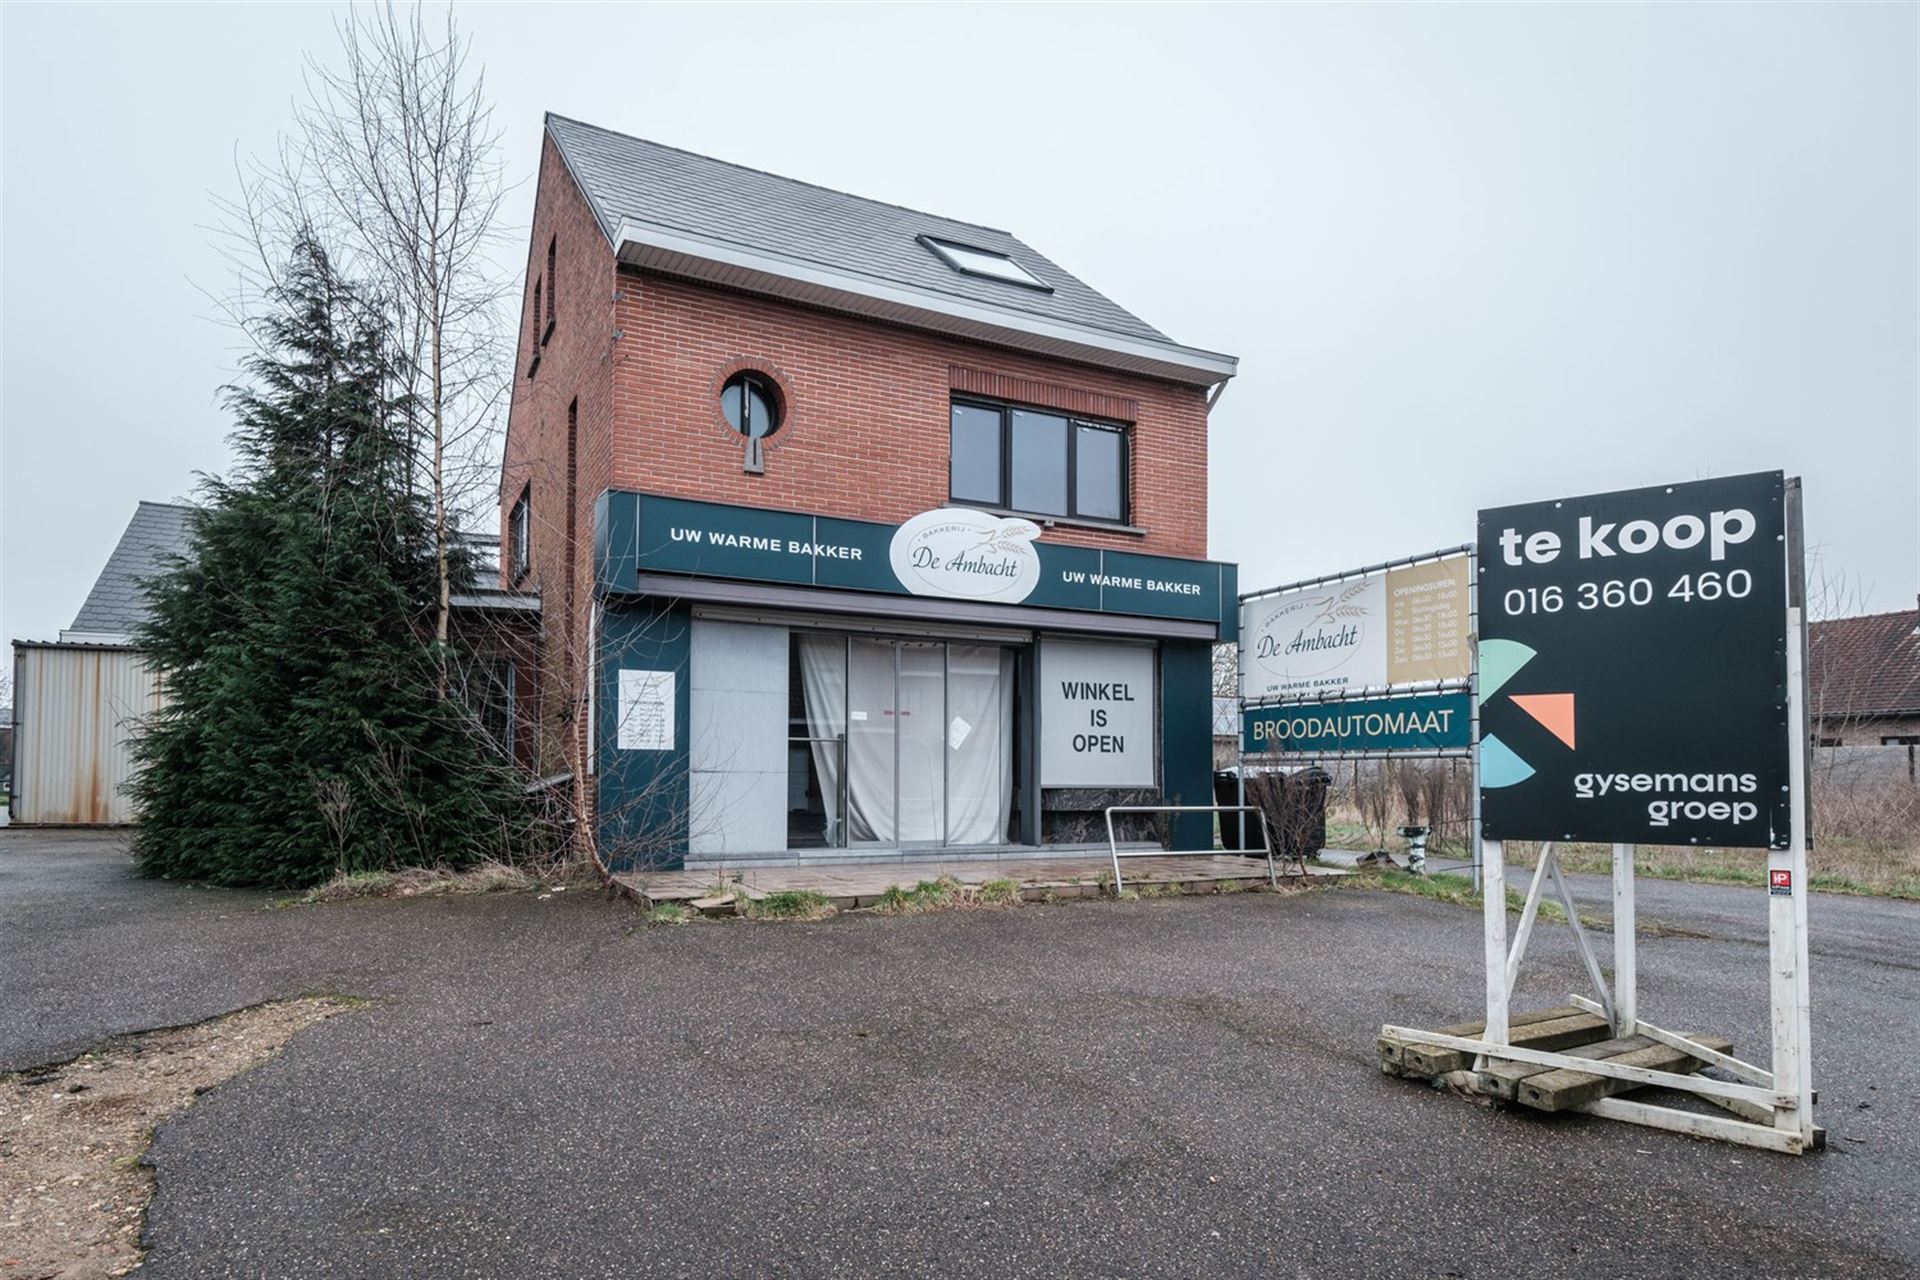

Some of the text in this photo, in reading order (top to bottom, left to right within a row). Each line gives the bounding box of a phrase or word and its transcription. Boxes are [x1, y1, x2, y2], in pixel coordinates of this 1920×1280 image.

[670, 527, 862, 560] UW WARME BAKKER
[922, 525, 966, 540] BAKKERIJ
[1499, 508, 1756, 566] te koop
[912, 546, 1017, 577] De Ambacht
[1062, 571, 1201, 595] UW WARME BAKKER
[1504, 569, 1752, 616] 016 360 460
[1264, 602, 1304, 628] BAKKERIJ
[1257, 624, 1357, 659] De Ambacht
[1061, 681, 1135, 701] WINKEL
[1280, 682, 1311, 690] WARME
[1313, 677, 1349, 687] BAKKER
[1090, 709, 1108, 727] IS
[1253, 709, 1454, 741] BROODAUTOMAAT
[1072, 734, 1124, 753] OPEN
[1574, 773, 1758, 798] gysemans
[1648, 801, 1758, 826] groep
